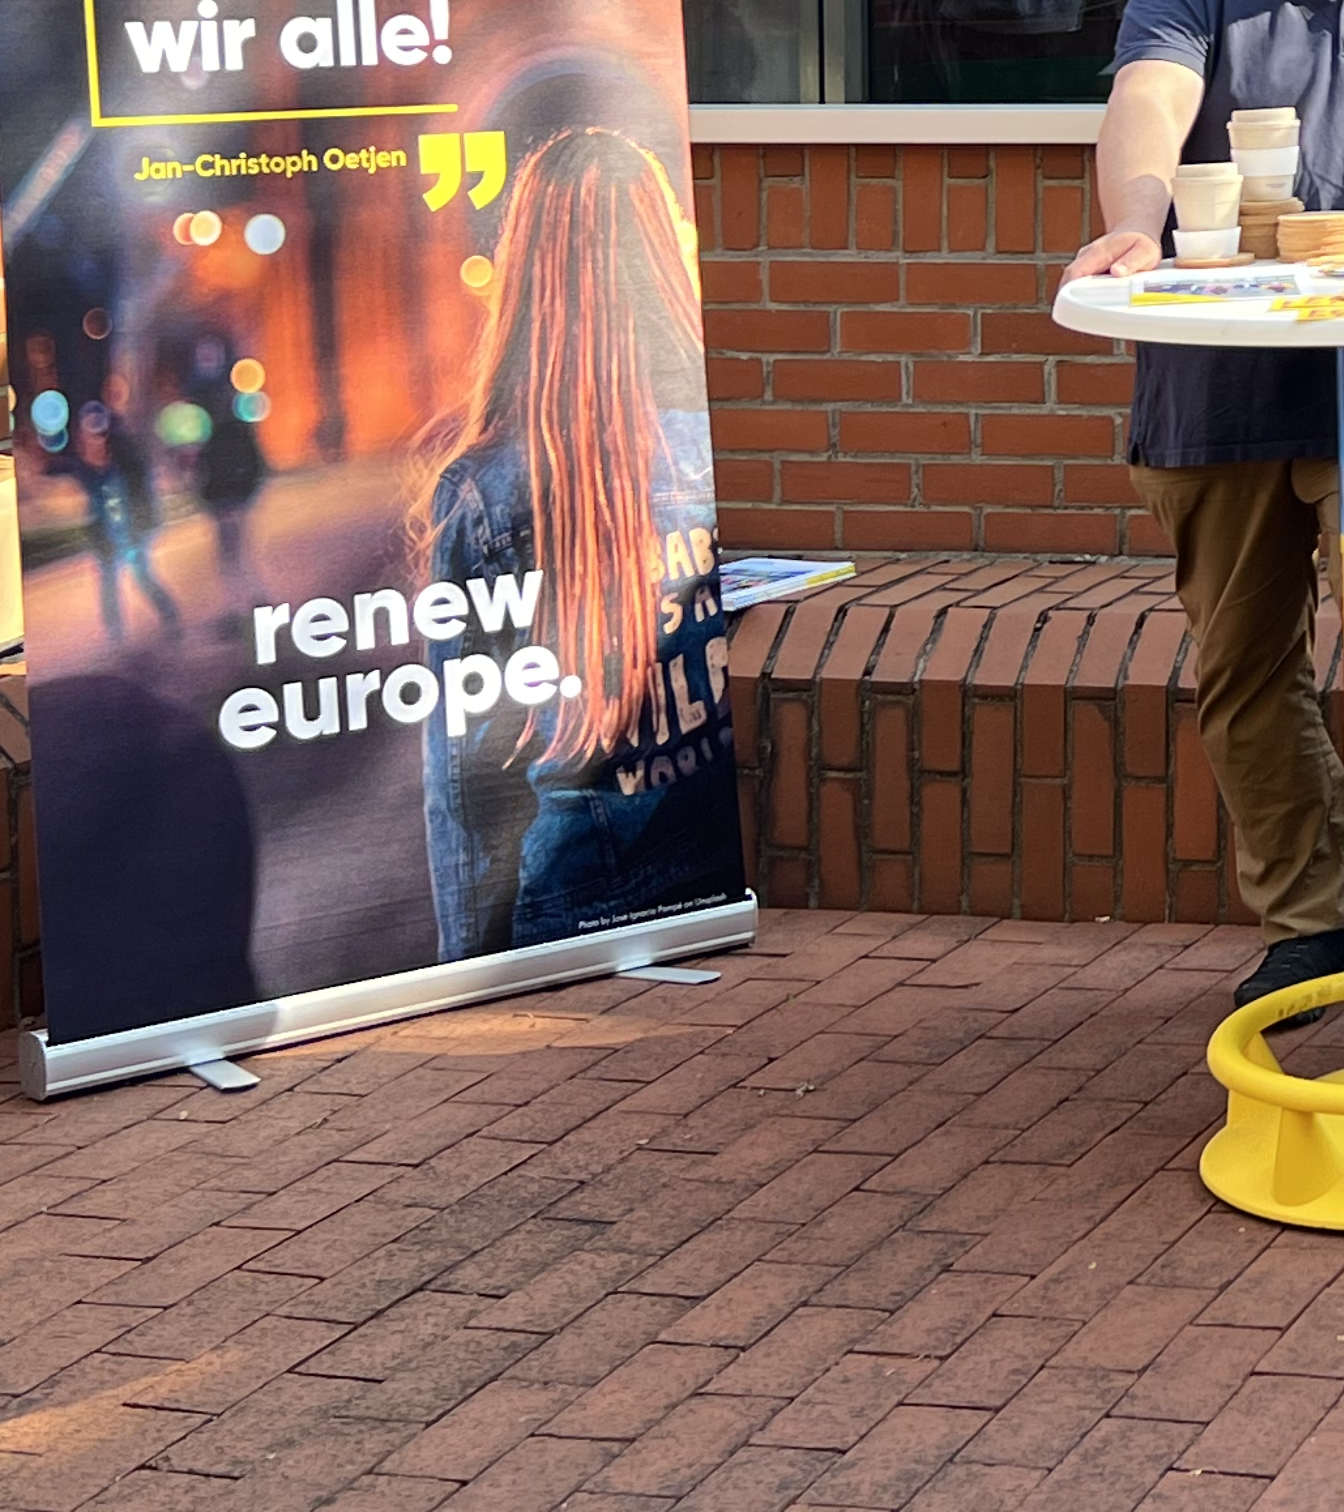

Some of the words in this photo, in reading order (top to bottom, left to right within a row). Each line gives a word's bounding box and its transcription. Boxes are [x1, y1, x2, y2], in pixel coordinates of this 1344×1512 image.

[125, 0, 256, 73] wir
[134, 149, 319, 180] Jan-Christoph
[322, 146, 407, 174] Oetjen
[650, 526, 719, 583] BAB
[252, 569, 545, 666] renew
[218, 643, 583, 751] europe.
